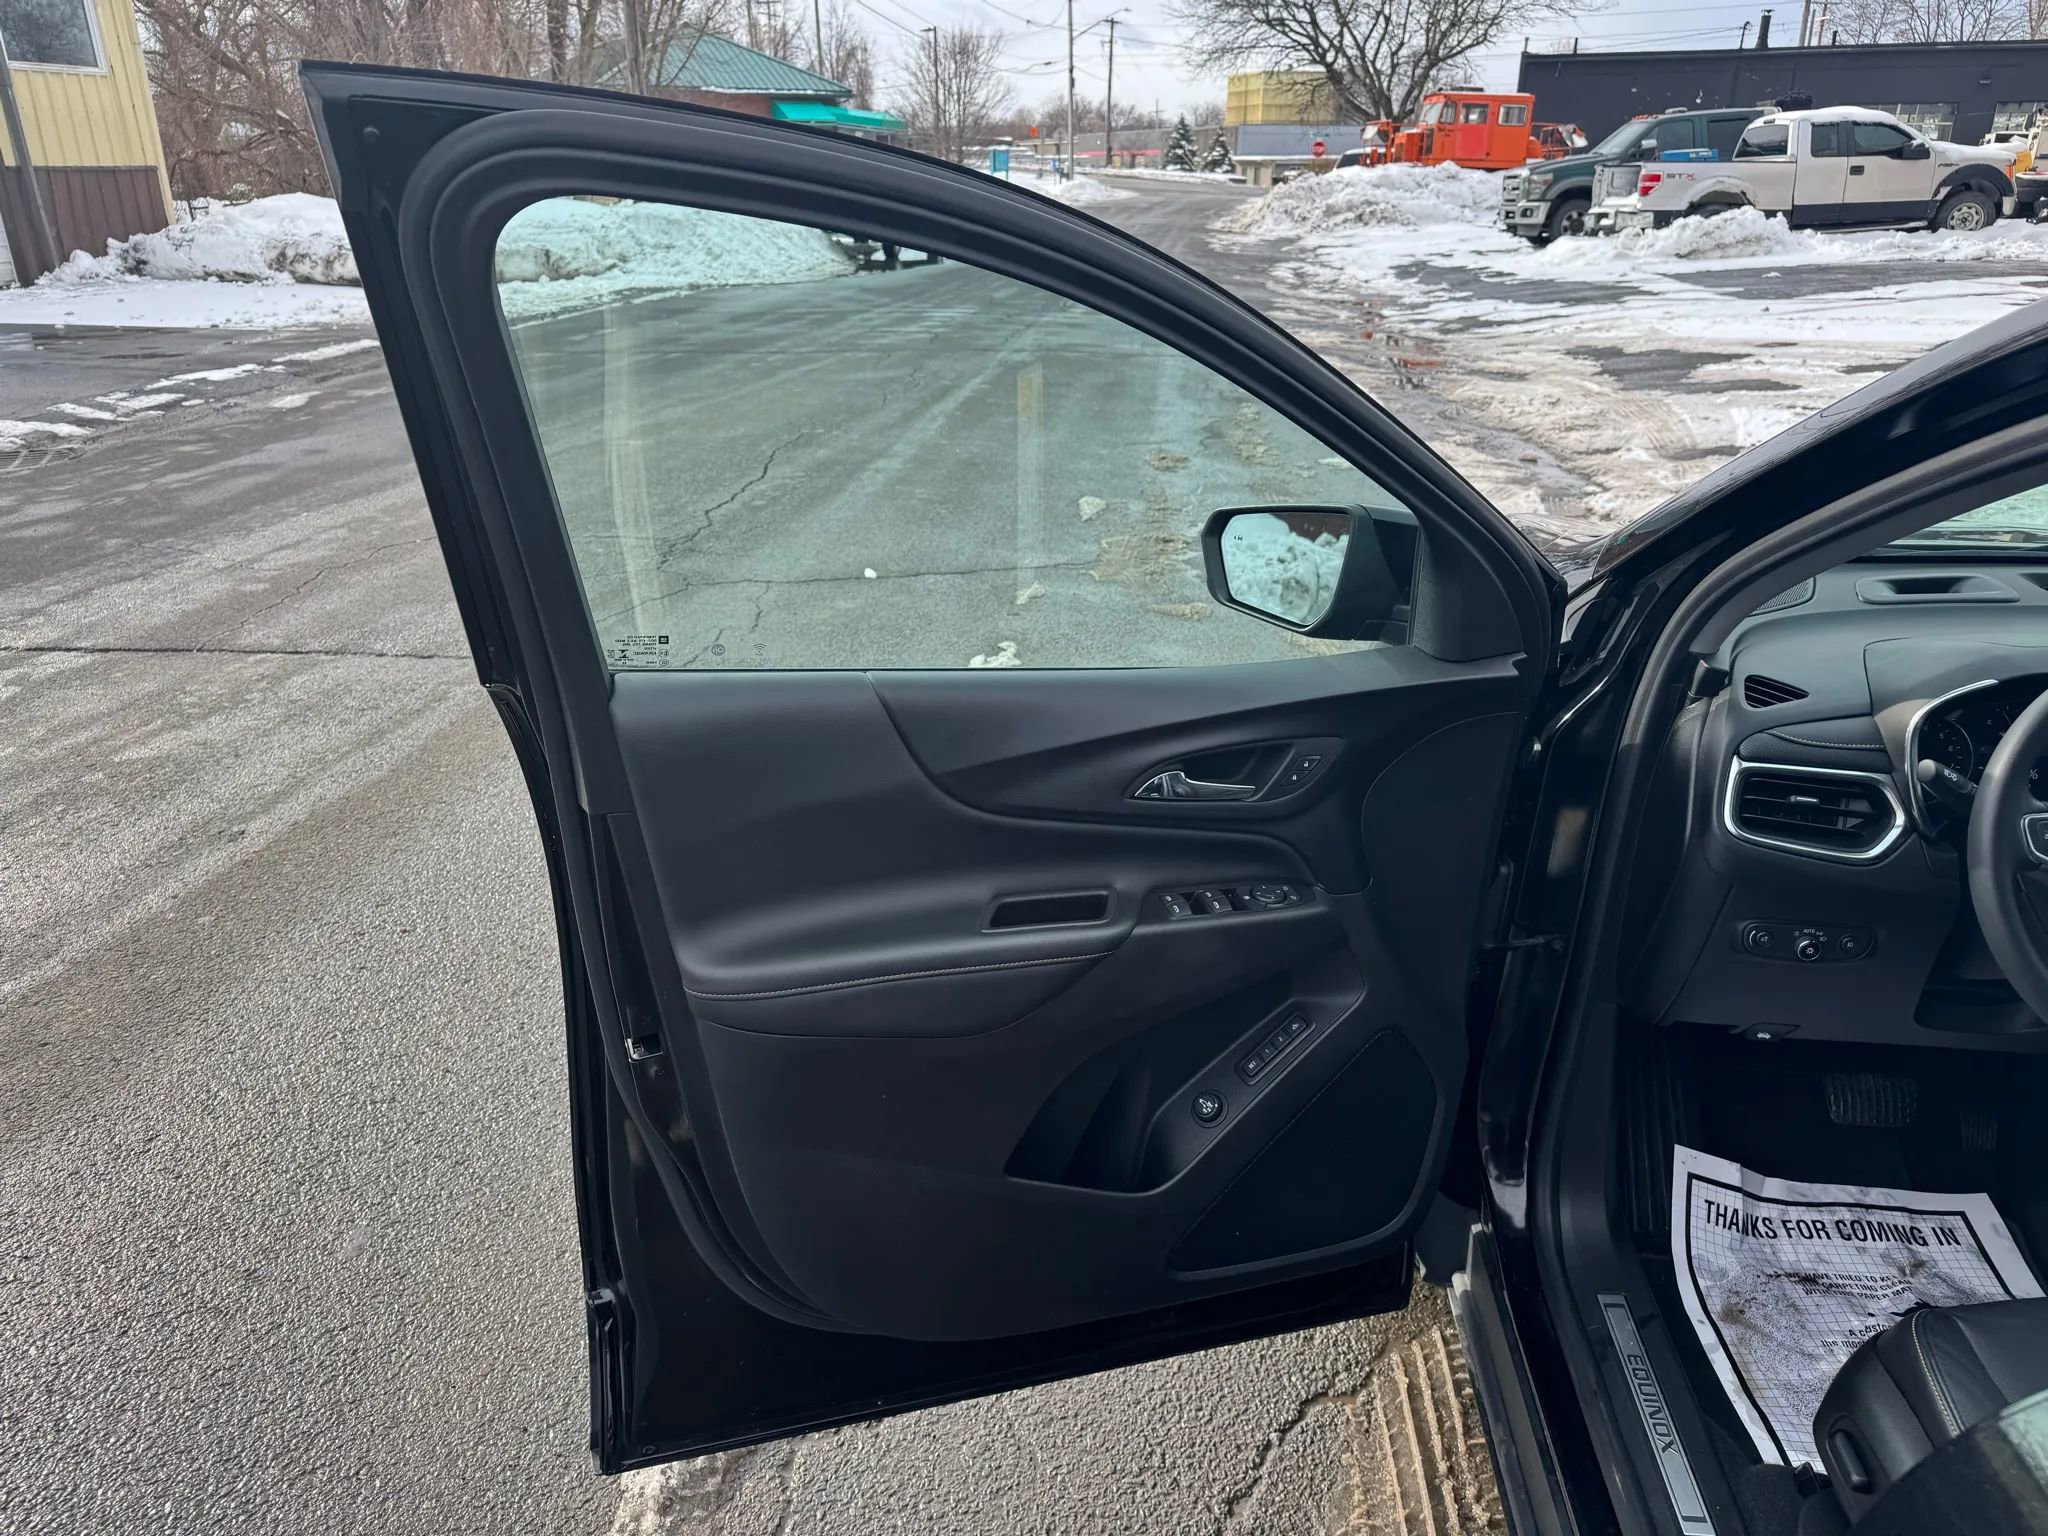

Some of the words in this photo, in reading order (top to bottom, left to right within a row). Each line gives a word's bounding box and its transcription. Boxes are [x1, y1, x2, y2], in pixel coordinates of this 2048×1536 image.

[1666, 173, 1696, 181] STX
[1704, 1199, 1778, 1240] THANKS
[1781, 1219, 1832, 1240] FOR
[1834, 1218, 1929, 1247] COMING
[1931, 1226, 1962, 1246] IN
[1832, 1273, 1862, 1282] TRIED
[1863, 1275, 1878, 1283] TO
[1820, 1282, 1878, 1292] CARPETING
[1880, 1279, 1913, 1291] CLEAN
[1802, 1287, 1831, 1296] WITH
[1857, 1292, 1890, 1301] PAPER
[1891, 1286, 1913, 1297] MAT
[1848, 1329, 1857, 1337] A
[1820, 1339, 1839, 1348] the
[1627, 1354, 1679, 1456] EQUINOX
